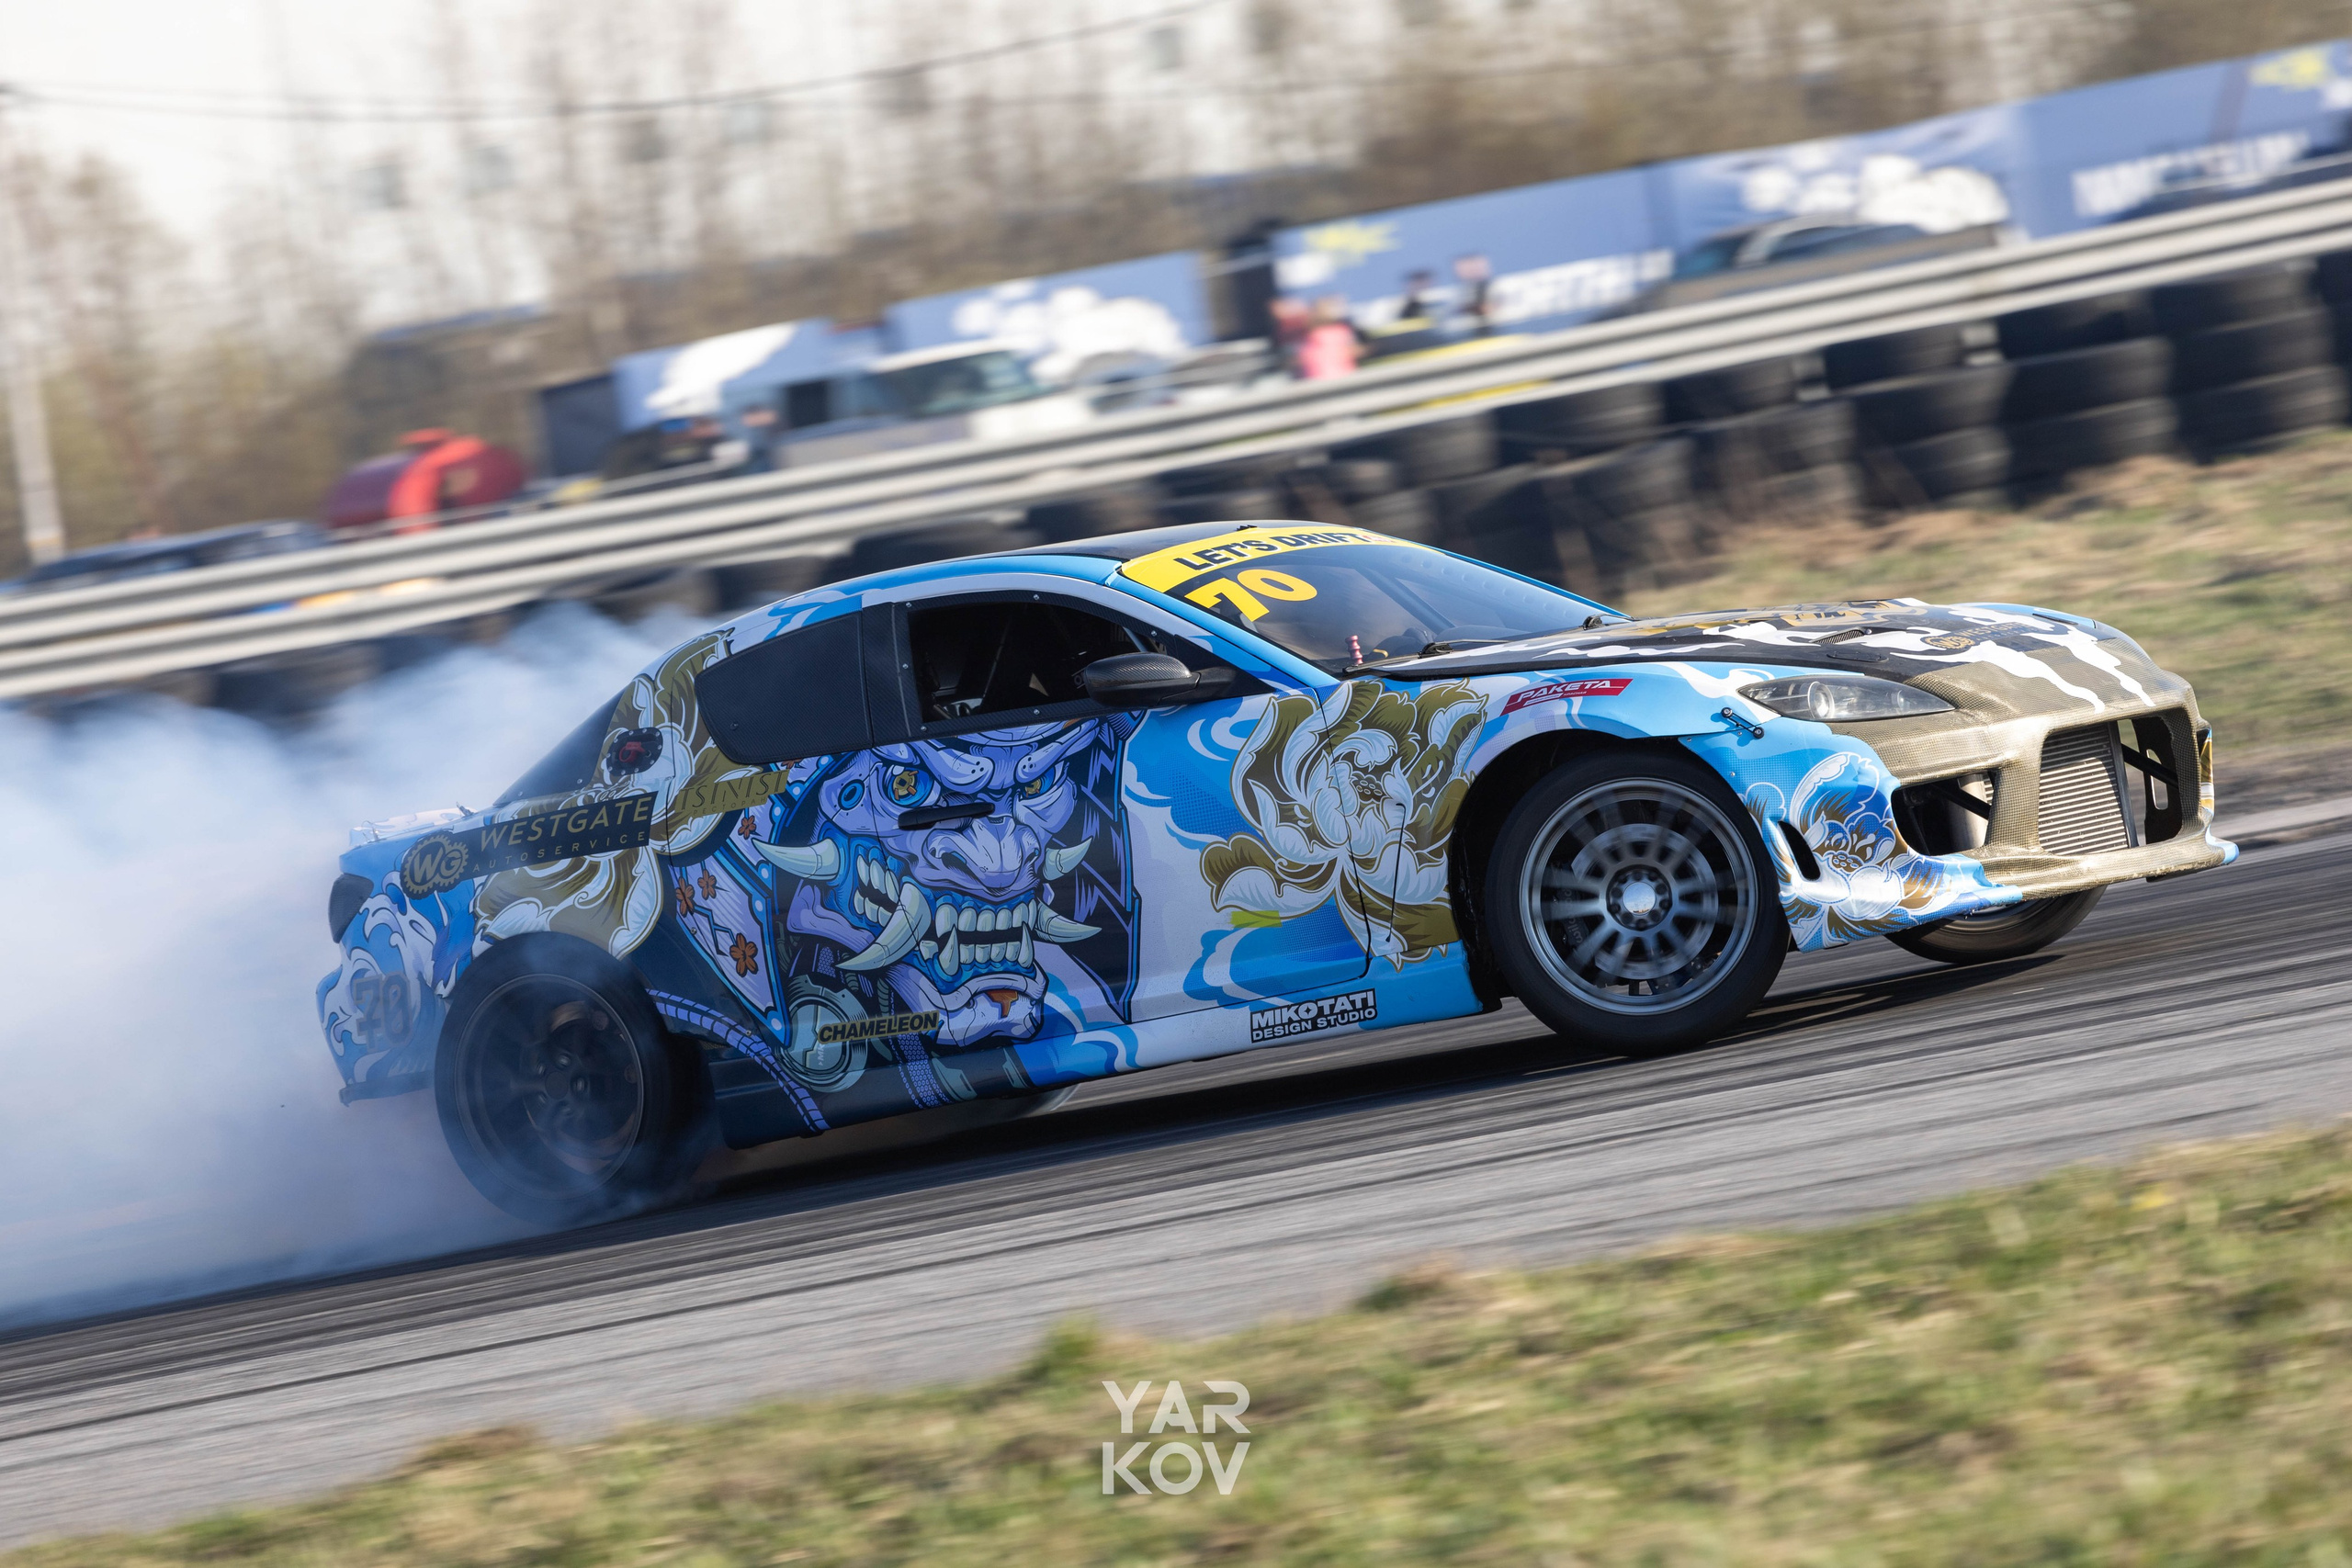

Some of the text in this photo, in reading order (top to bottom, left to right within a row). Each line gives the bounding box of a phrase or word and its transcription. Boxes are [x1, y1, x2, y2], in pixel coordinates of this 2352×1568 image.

[1173, 532, 1372, 571] LET'S DRIFT
[1183, 569, 1318, 623] 70
[680, 770, 789, 810] TSINIST
[693, 797, 768, 817] РЕСТОРАН
[481, 795, 652, 852] WESTGATE
[413, 845, 462, 886] WG
[471, 830, 646, 873] AUTOSERVICE
[353, 970, 414, 1054] 70
[819, 1011, 939, 1043] CHAMELEON
[1252, 990, 1374, 1030] MIKOTATI
[1252, 1009, 1376, 1041] DESIGN STUDIO
